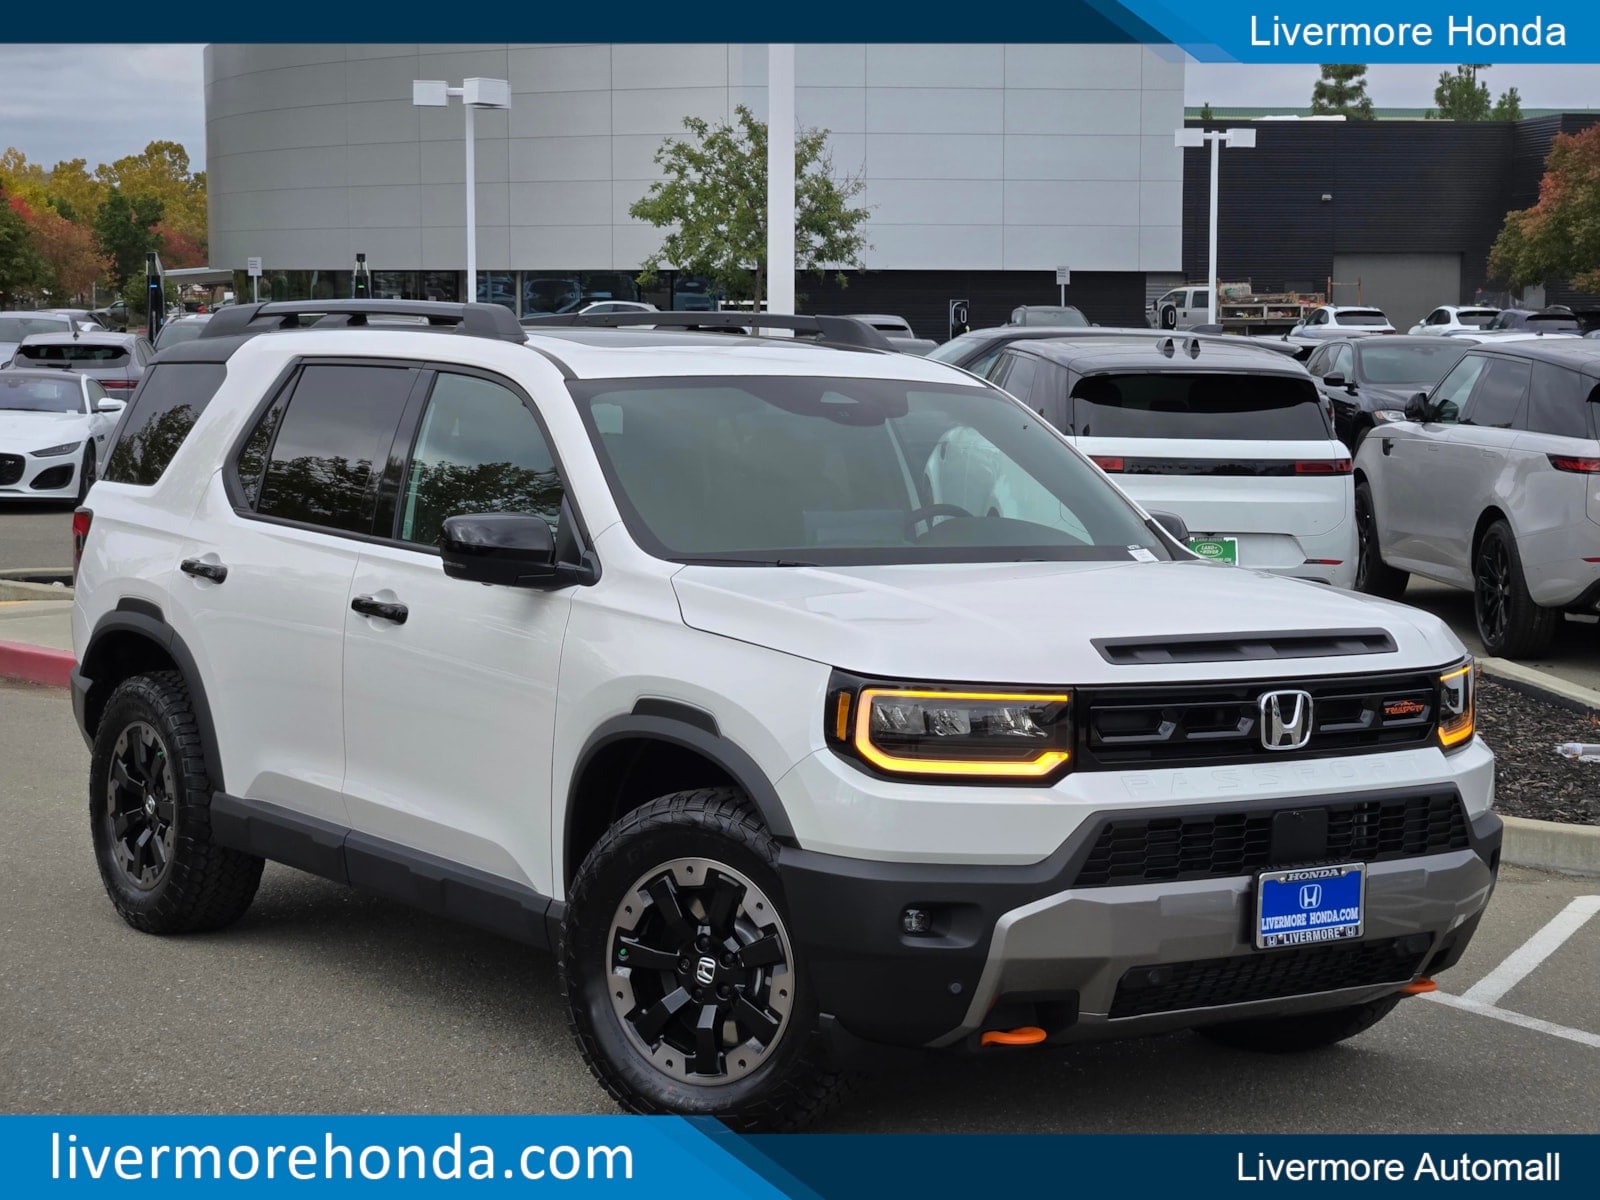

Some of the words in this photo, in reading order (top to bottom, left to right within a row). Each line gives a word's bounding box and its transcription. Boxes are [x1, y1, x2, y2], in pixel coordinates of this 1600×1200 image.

[1287, 869, 1340, 881] HONDA
[1261, 913, 1307, 931] LIVERMORE
[1309, 907, 1359, 925] HONDA.COM
[1283, 927, 1341, 944] LIVERMORE
